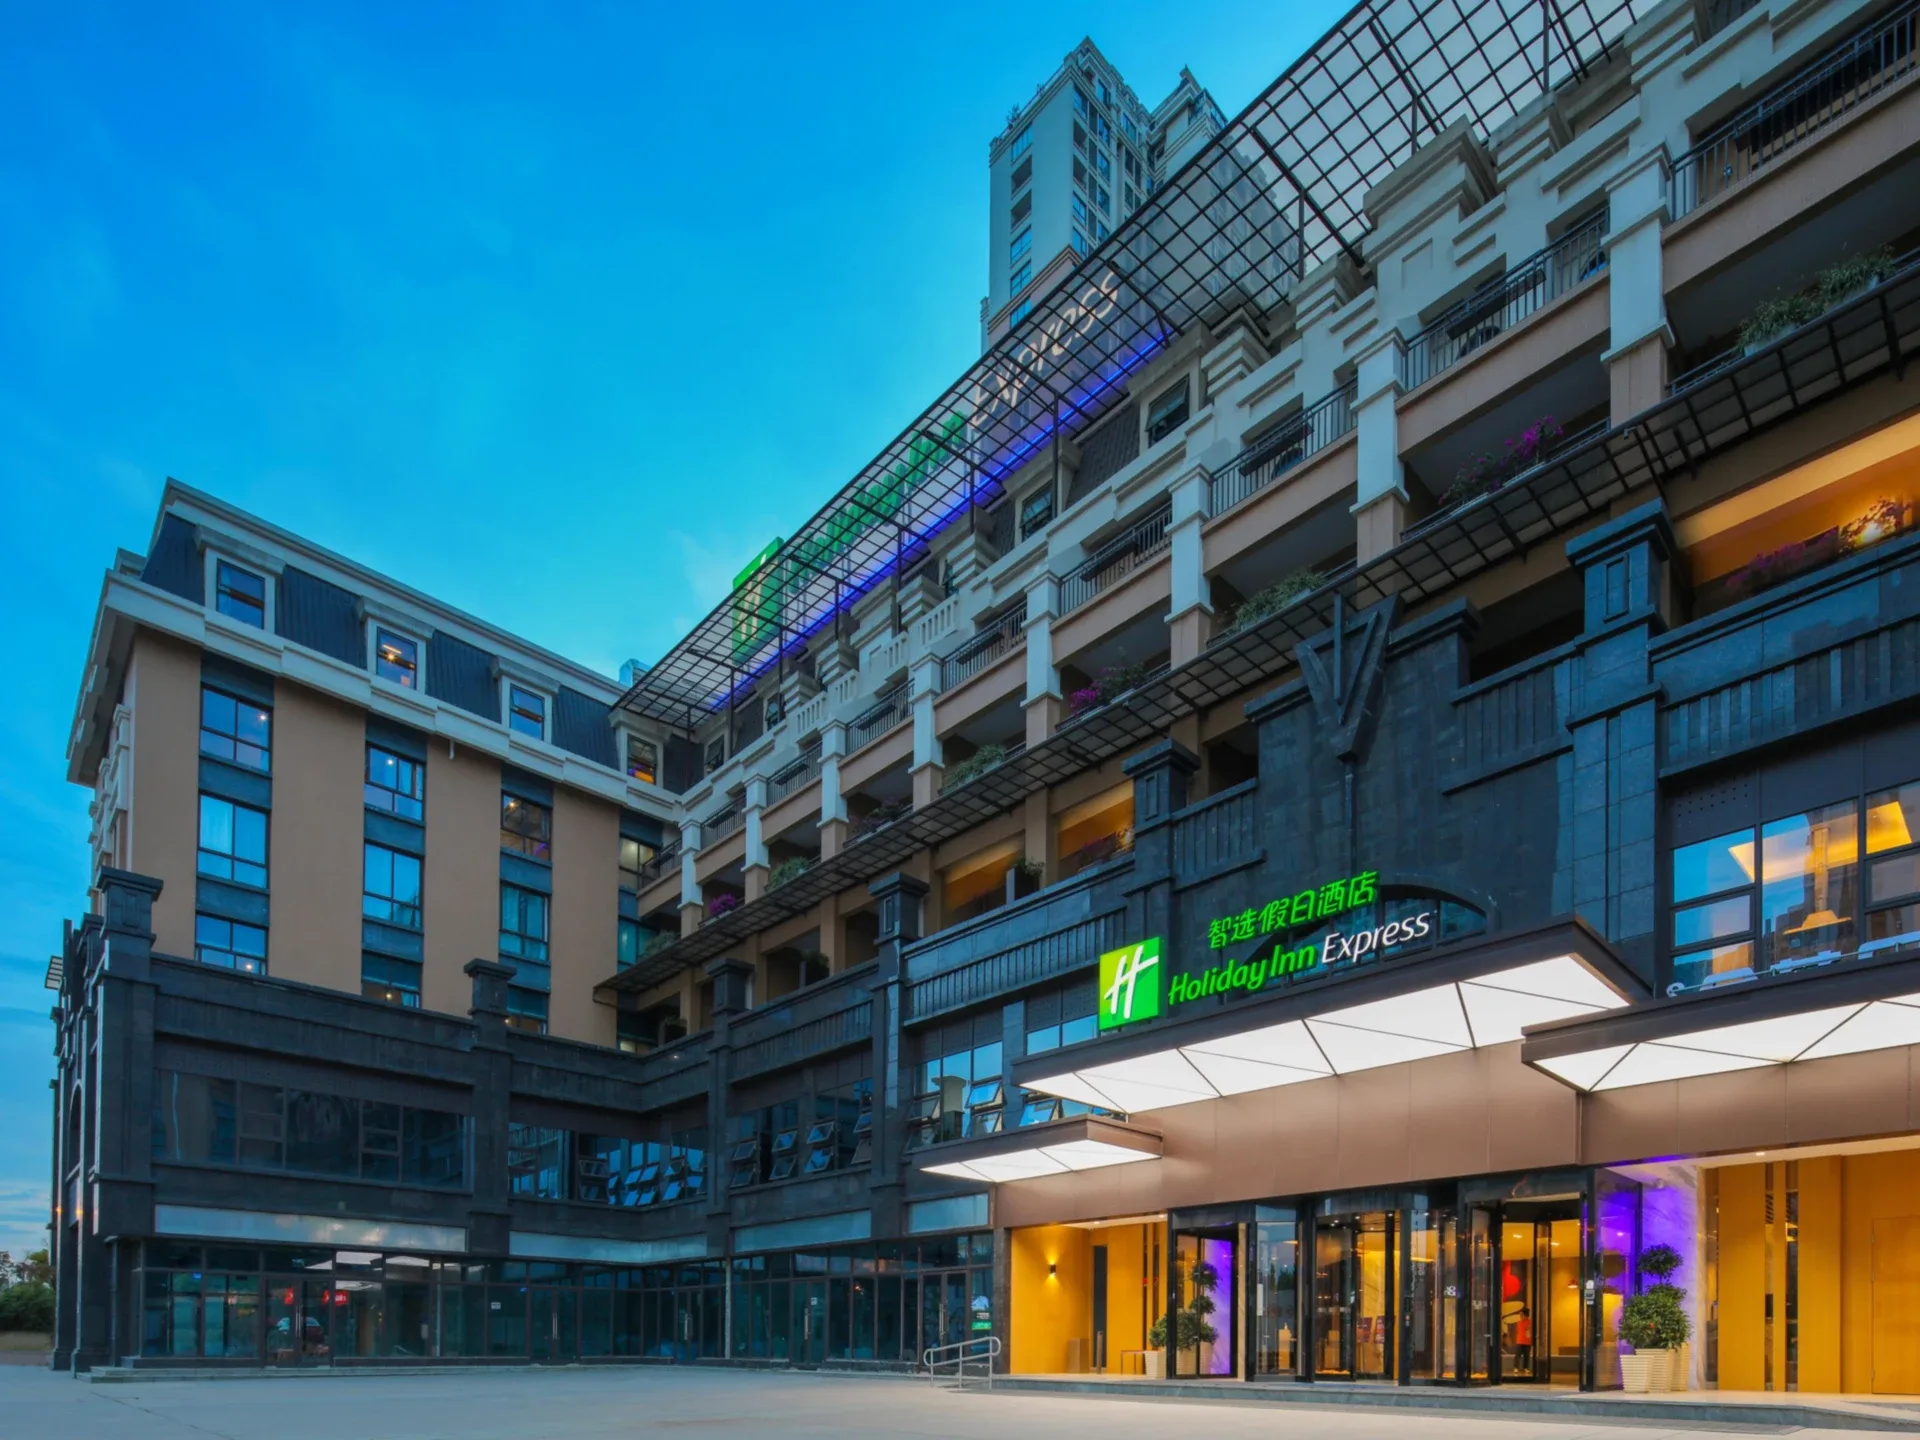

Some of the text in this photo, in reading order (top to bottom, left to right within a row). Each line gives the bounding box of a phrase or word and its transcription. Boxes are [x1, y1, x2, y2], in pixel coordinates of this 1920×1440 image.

[971, 270, 1119, 430] Express
[1208, 870, 1379, 949] 智选假日酒店
[1168, 911, 1431, 1005] Holiday Inn Express
